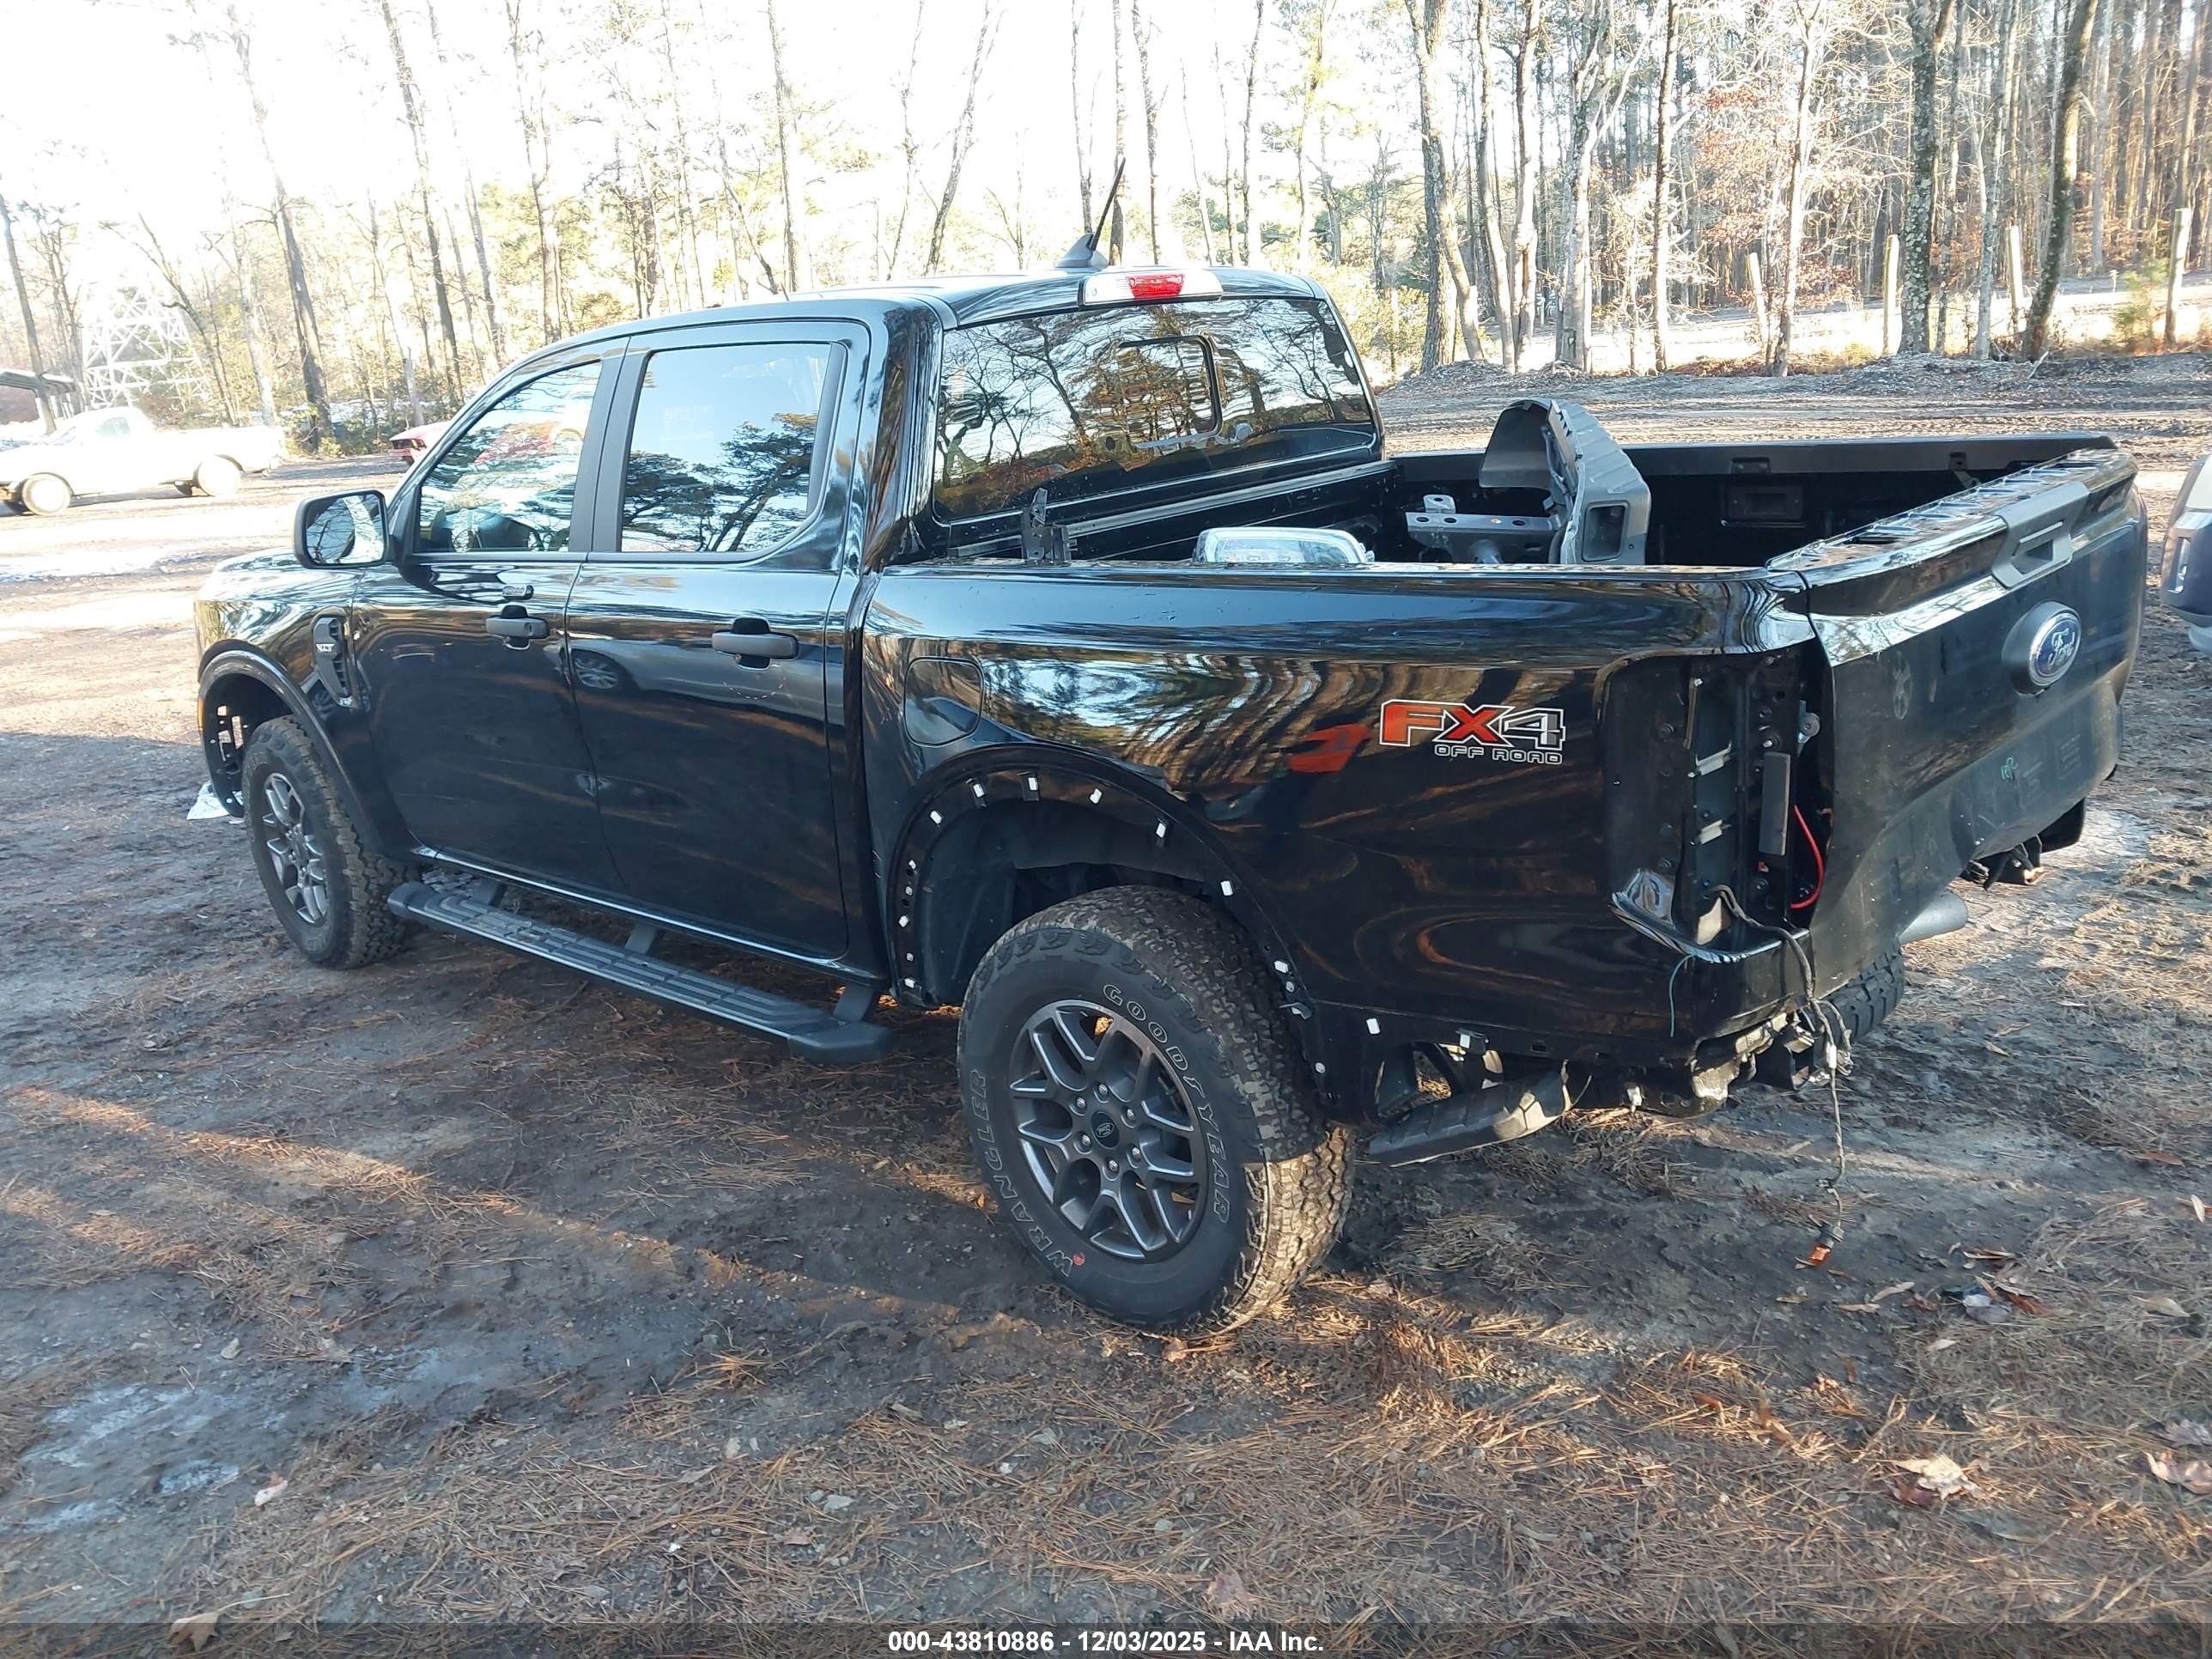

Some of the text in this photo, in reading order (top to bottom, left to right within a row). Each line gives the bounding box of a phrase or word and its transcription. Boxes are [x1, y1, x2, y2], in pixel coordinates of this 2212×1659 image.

[1379, 699, 1566, 751] FX4
[1434, 744, 1563, 764] OFF ROAD
[1103, 983, 1231, 1225] GOODYEAR
[970, 1069, 1074, 1278] WRANGLER
